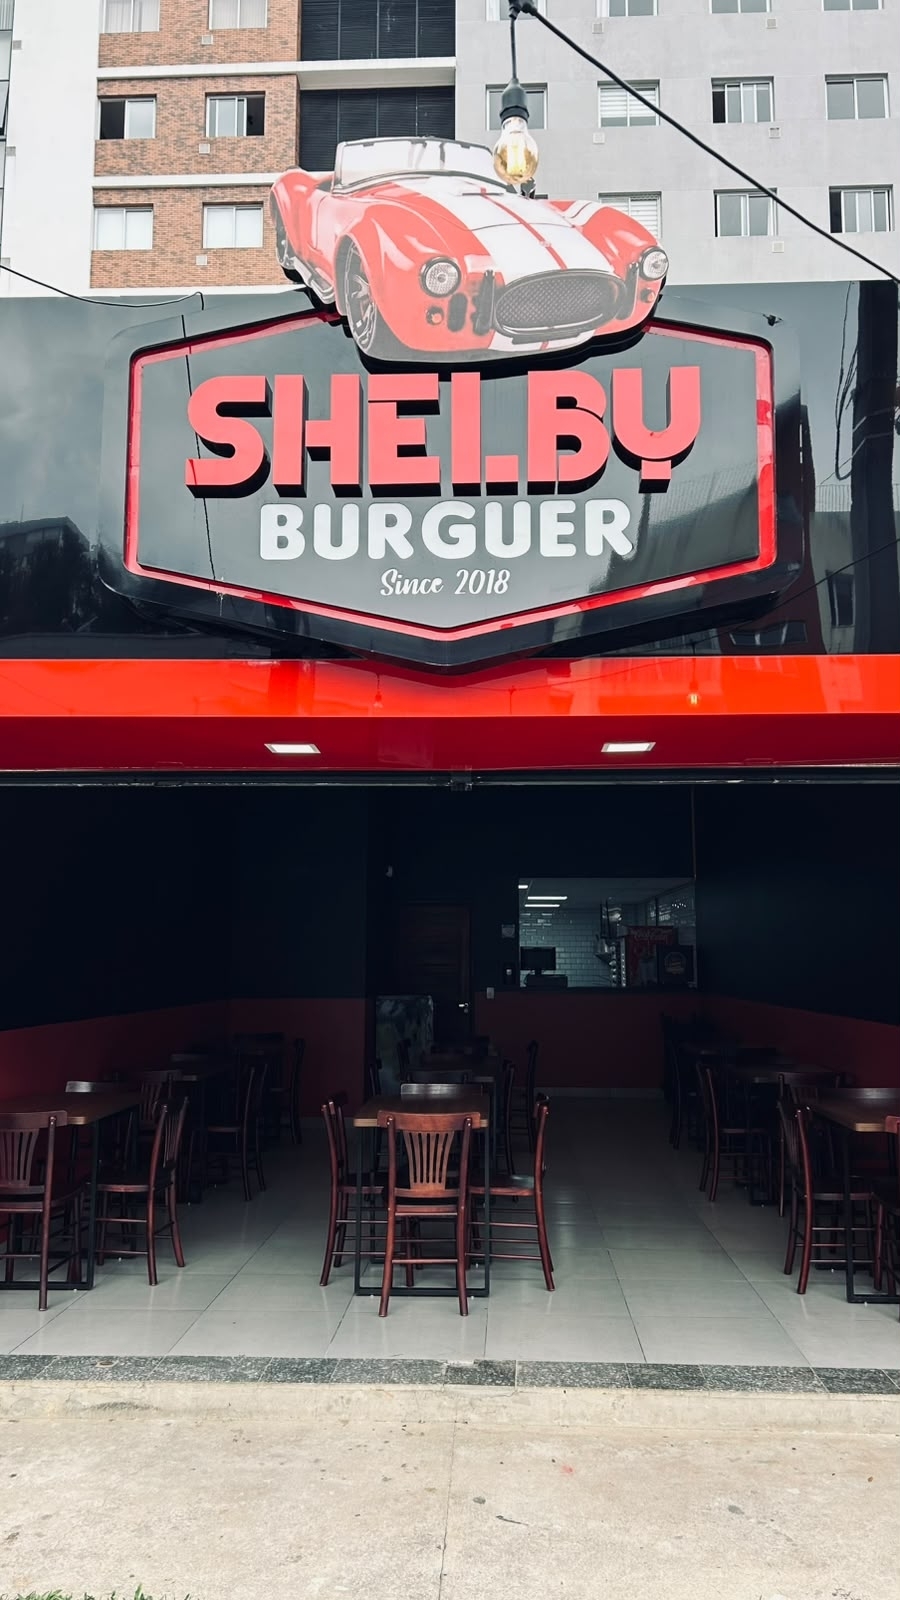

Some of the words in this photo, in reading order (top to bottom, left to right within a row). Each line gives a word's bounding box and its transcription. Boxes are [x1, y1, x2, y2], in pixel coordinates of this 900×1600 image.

[185, 366, 702, 497] SHELBY
[259, 499, 633, 560] BURGUER
[380, 568, 444, 596] Since
[454, 568, 511, 595] 2018
